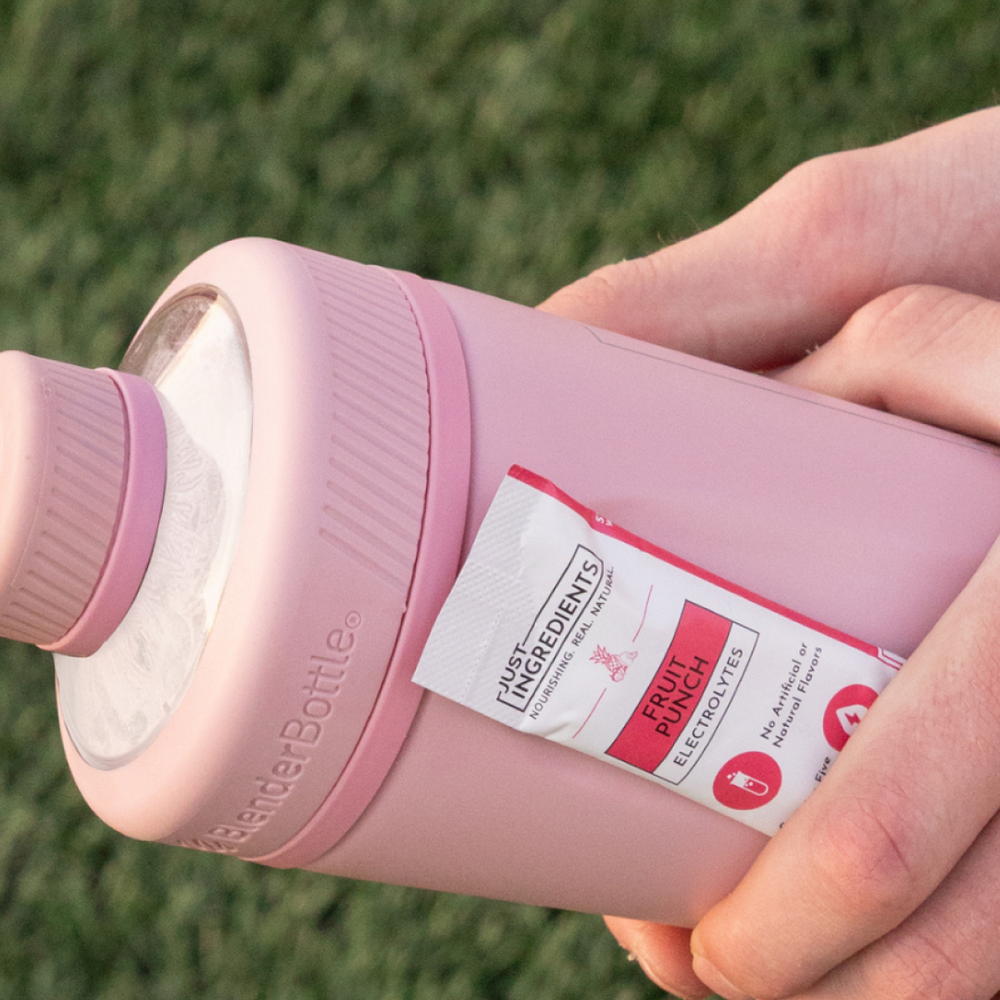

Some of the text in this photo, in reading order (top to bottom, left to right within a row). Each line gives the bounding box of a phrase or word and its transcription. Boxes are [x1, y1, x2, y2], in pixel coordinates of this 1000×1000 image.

[498, 643, 525, 693] JUST
[511, 560, 599, 700] INGREDIENTS
[529, 565, 615, 720] NOURISHING. REAL. NATURAL.
[641, 655, 687, 721] FRUIT
[655, 655, 709, 737] PUNCH
[673, 646, 744, 767] ELECTROLYTES
[760, 642, 808, 740] No Artificial or
[773, 646, 823, 748] Natural Flavors
[814, 756, 831, 782] Five
